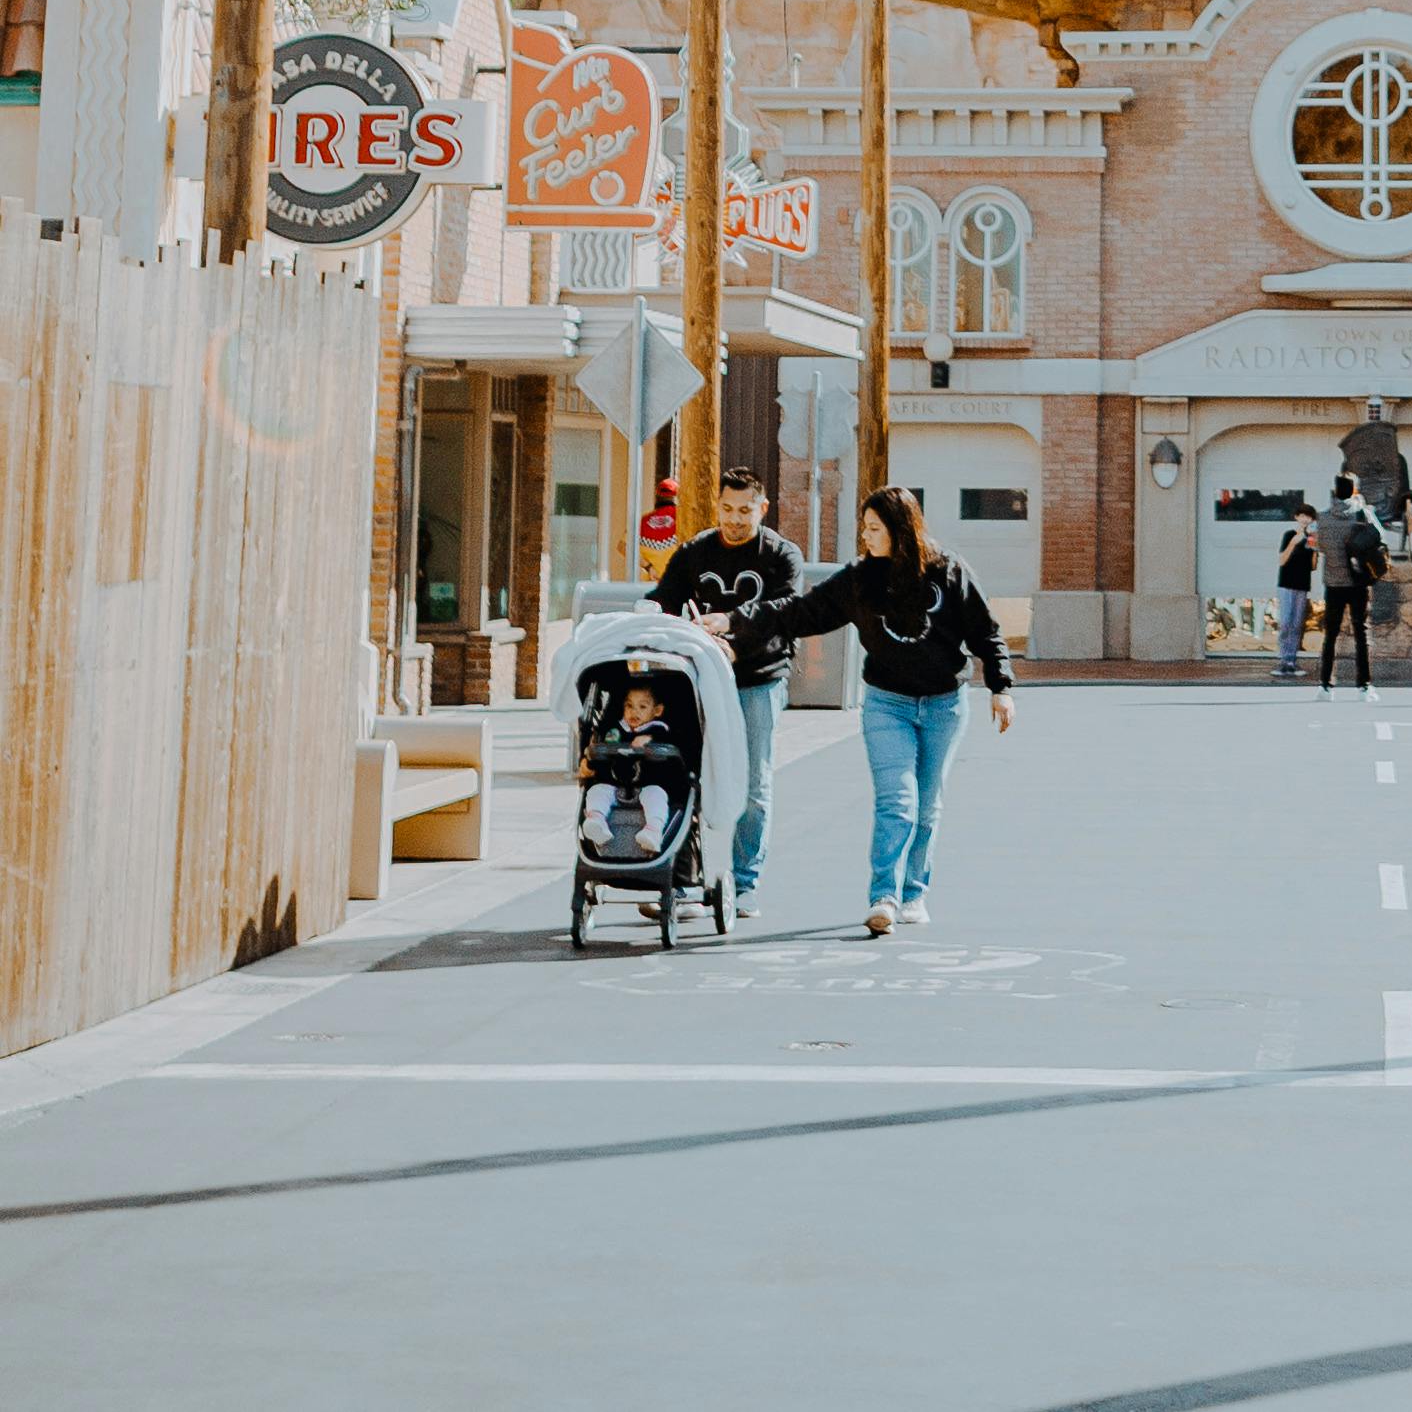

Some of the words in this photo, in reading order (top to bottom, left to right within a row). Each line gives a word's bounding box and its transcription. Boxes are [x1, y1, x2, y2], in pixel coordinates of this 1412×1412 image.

[271, 52, 317, 91] ASA
[324, 50, 398, 105] DELLA
[523, 79, 626, 150] Curb
[267, 105, 464, 173] IRES
[518, 125, 640, 201] Feeler
[267, 187, 319, 228] ALITY
[728, 186, 808, 249] PLUGS
[1204, 345, 1381, 371] RADIATOR
[1323, 327, 1382, 344] TOWN
[890, 400, 936, 416] AFFIC
[948, 400, 1014, 416] COURT
[1291, 402, 1331, 417] FIRE
